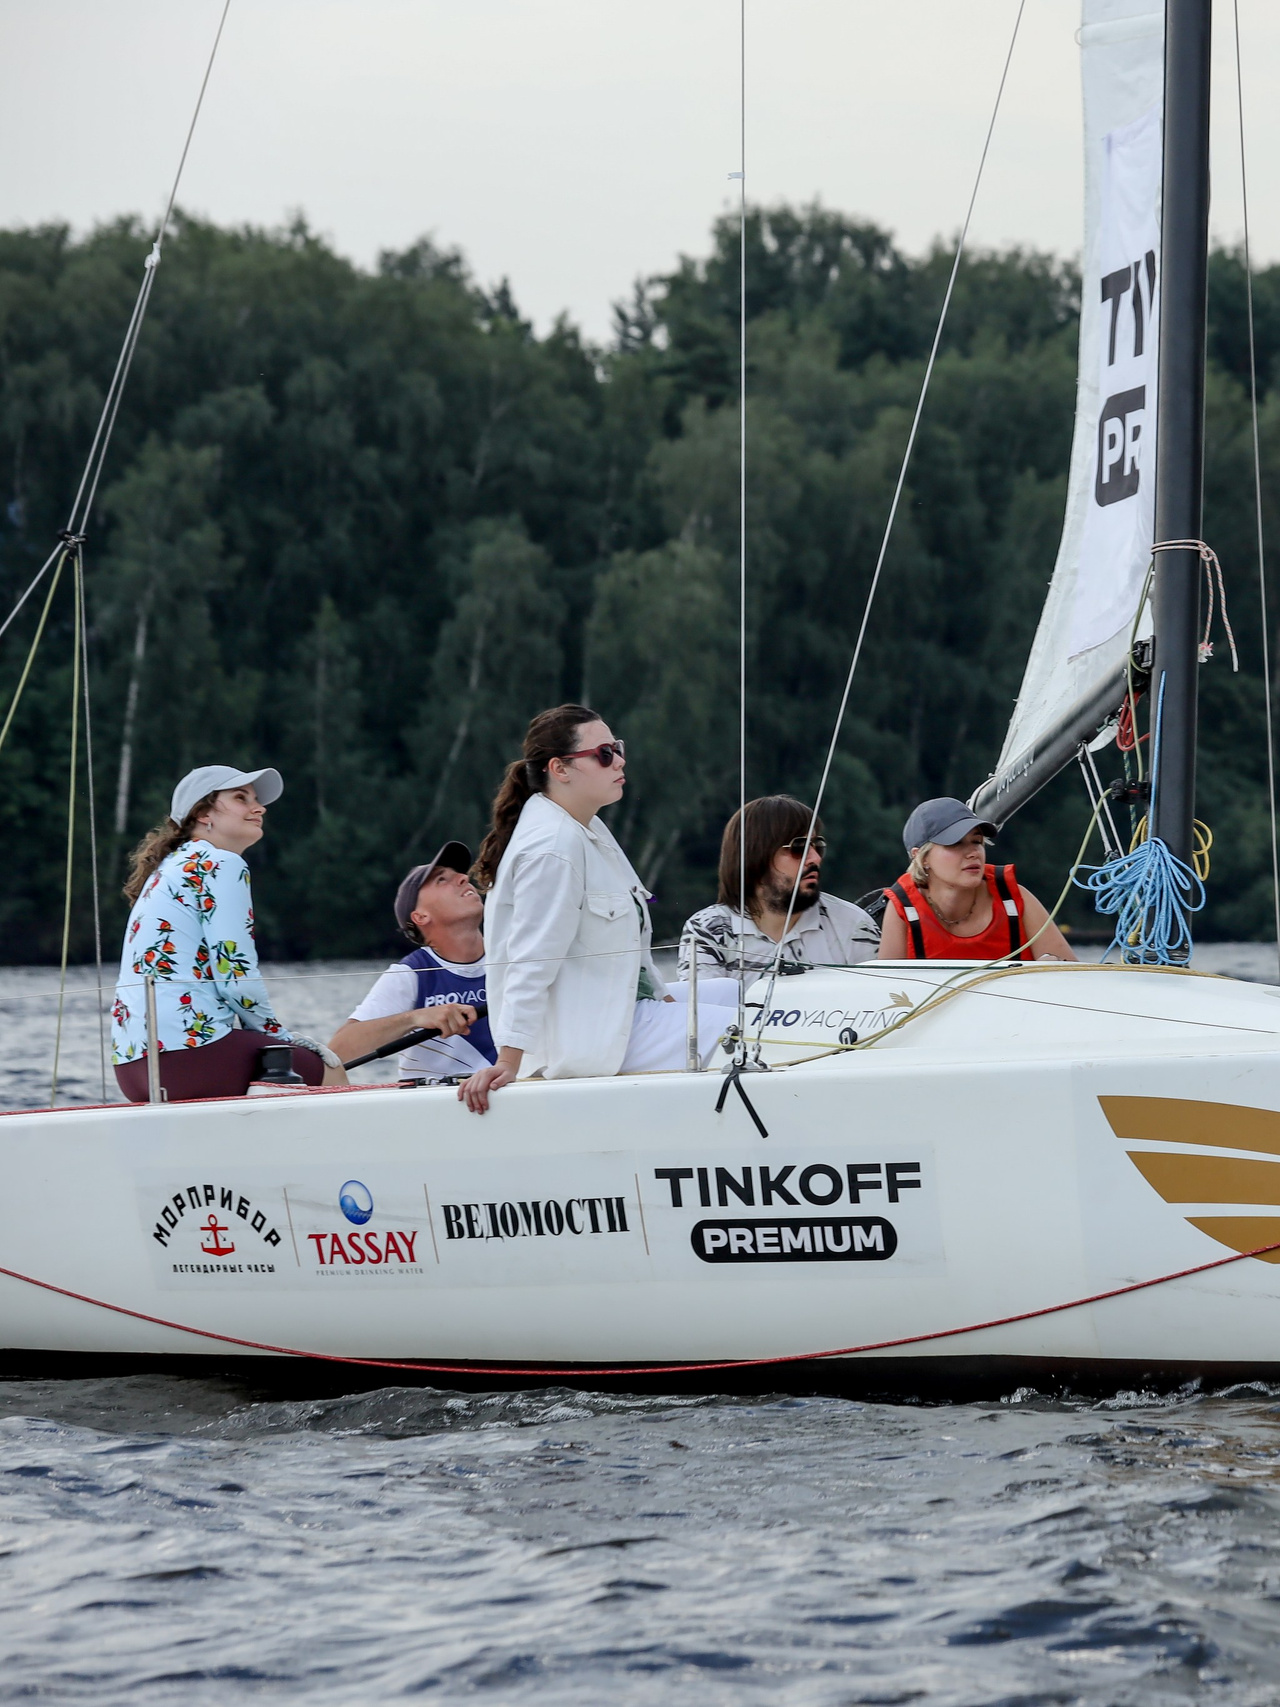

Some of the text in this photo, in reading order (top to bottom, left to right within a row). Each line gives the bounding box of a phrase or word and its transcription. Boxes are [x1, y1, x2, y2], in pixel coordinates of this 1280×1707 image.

[654, 1161, 922, 1208] TINKOFF
[152, 1184, 282, 1248] МОРПРИБОР
[441, 1196, 631, 1244] ВЕДОМОСТИ
[307, 1230, 419, 1265] TASSAY
[701, 1224, 886, 1255] PREMIUM
[172, 1263, 276, 1274] ЛЕГЕНДАРНЫЕ ЧАСЫ
[316, 1267, 425, 1277] PREMIUM DRINKING WATER
